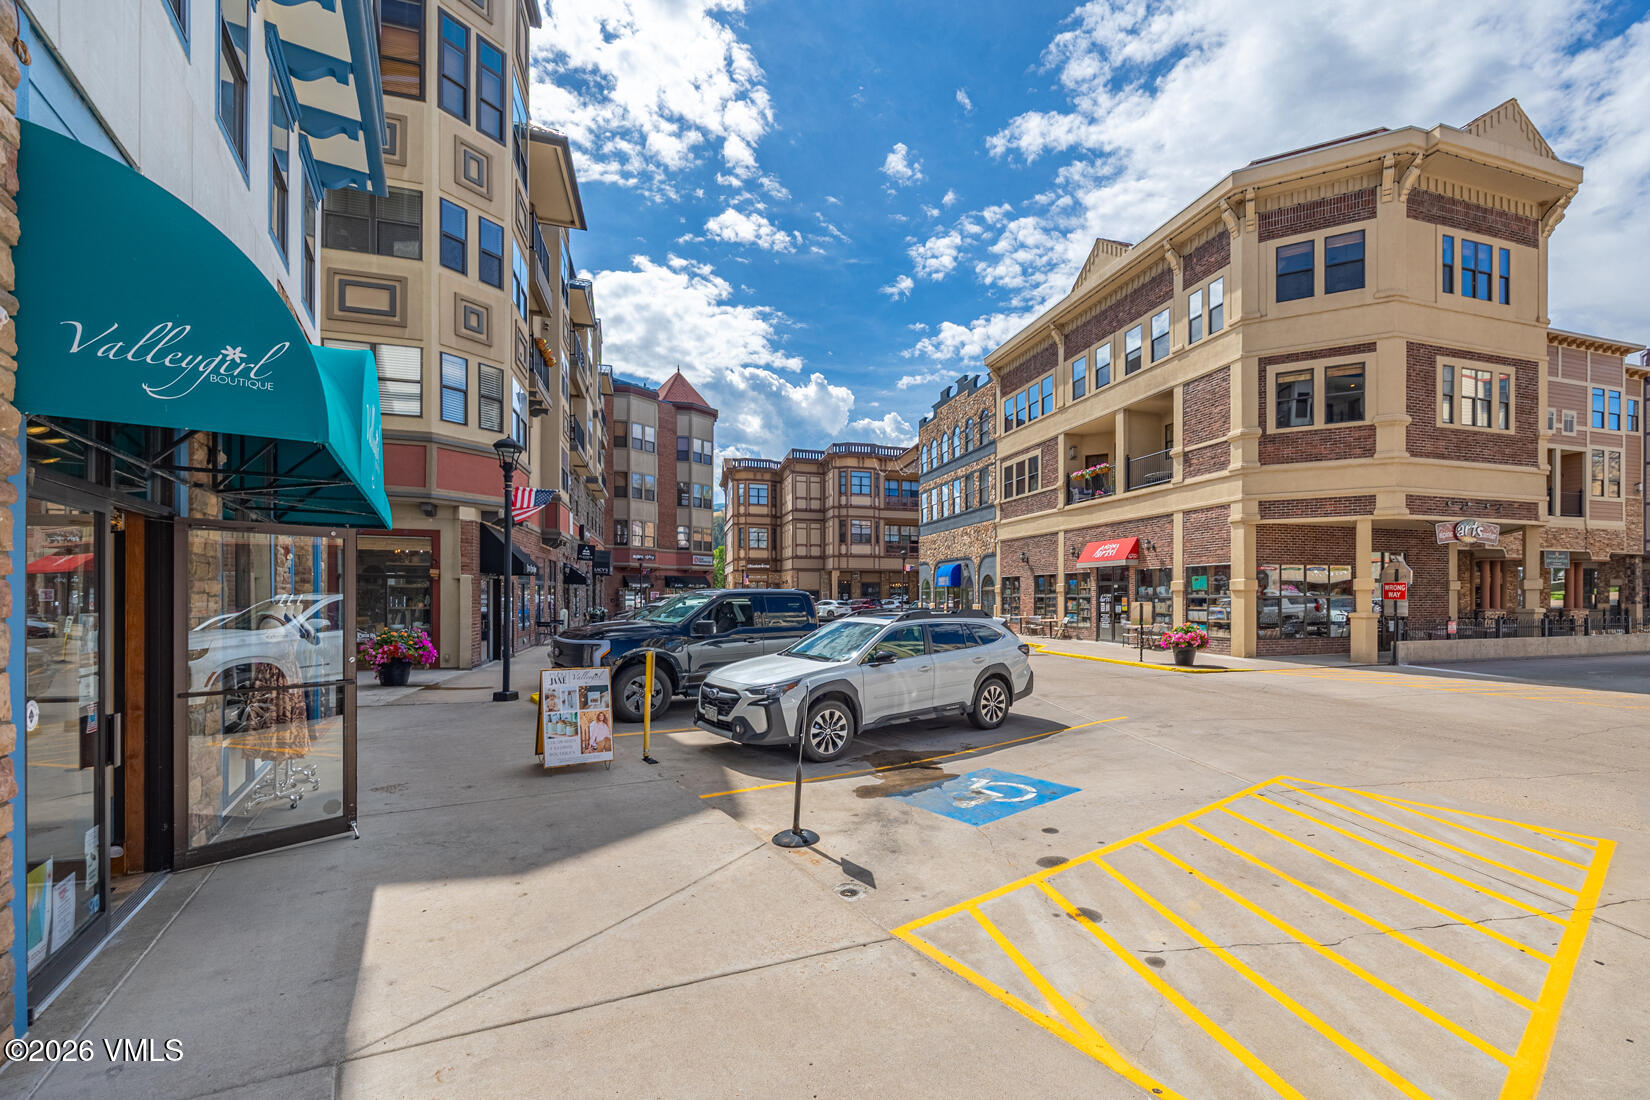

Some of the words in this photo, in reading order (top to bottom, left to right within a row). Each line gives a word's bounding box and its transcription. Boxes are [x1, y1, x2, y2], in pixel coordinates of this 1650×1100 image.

[59, 320, 290, 399] Valleygirl
[210, 374, 274, 391] BOUTIQUE
[1457, 521, 1484, 538] arts
